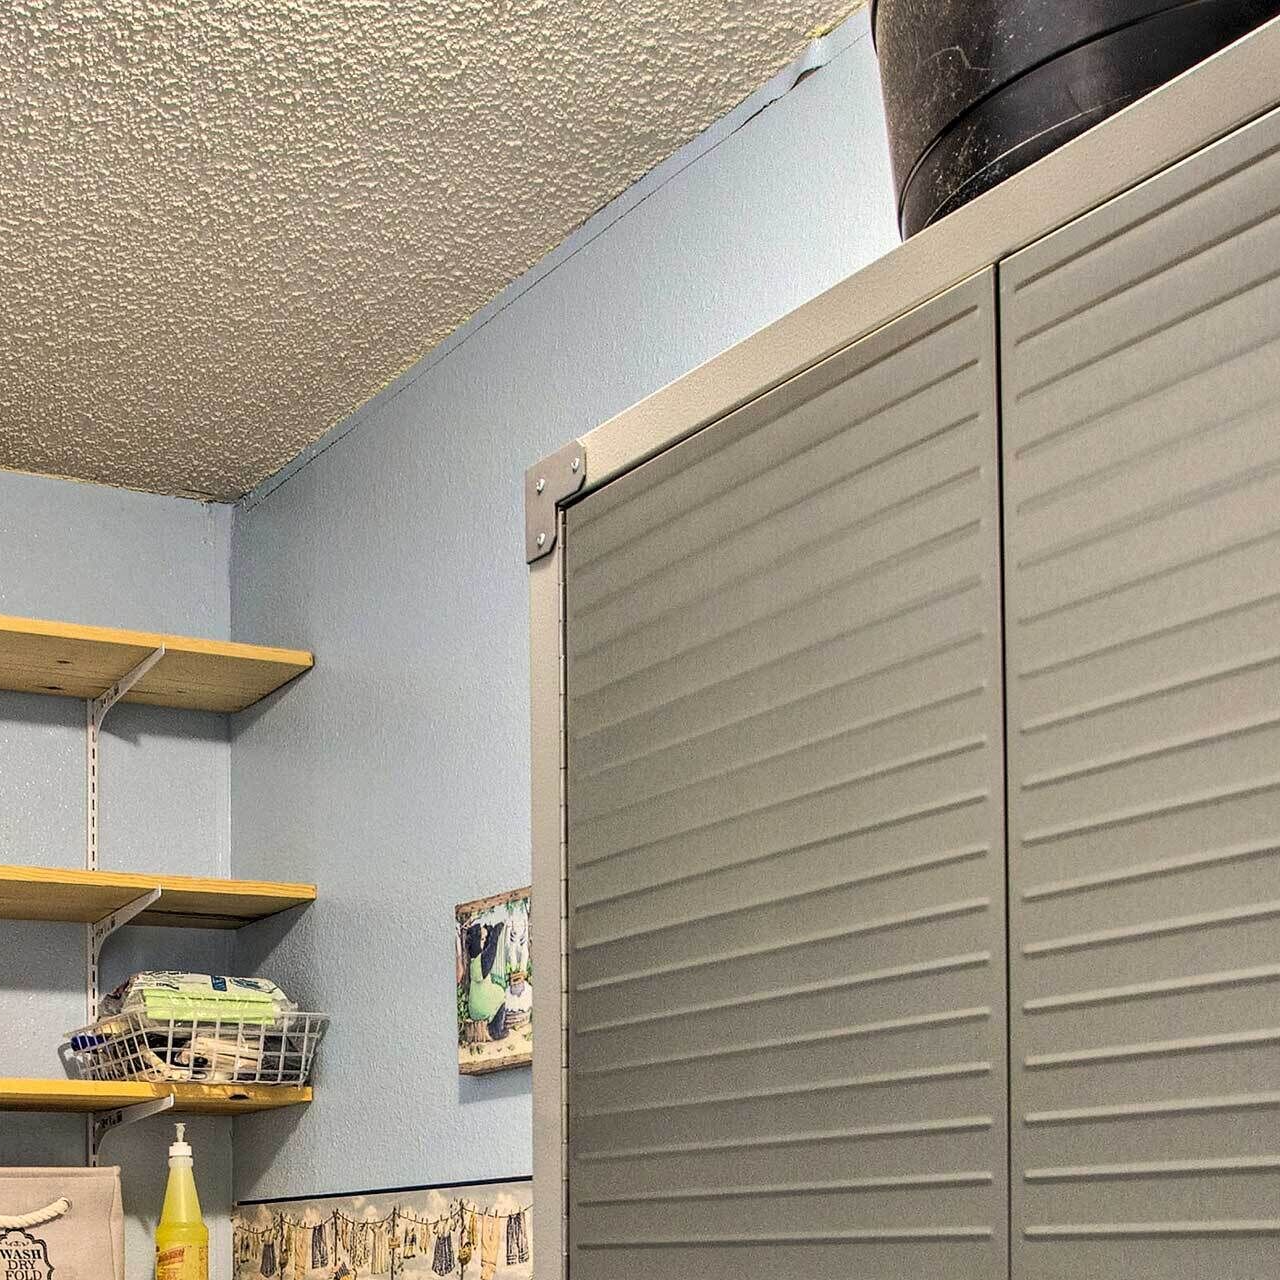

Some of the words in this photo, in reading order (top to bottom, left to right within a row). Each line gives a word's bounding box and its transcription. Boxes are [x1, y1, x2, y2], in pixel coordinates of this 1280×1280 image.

[0, 1248, 42, 1260] WASH
[7, 1259, 36, 1270] DRY
[5, 1270, 43, 1280] FOLD
